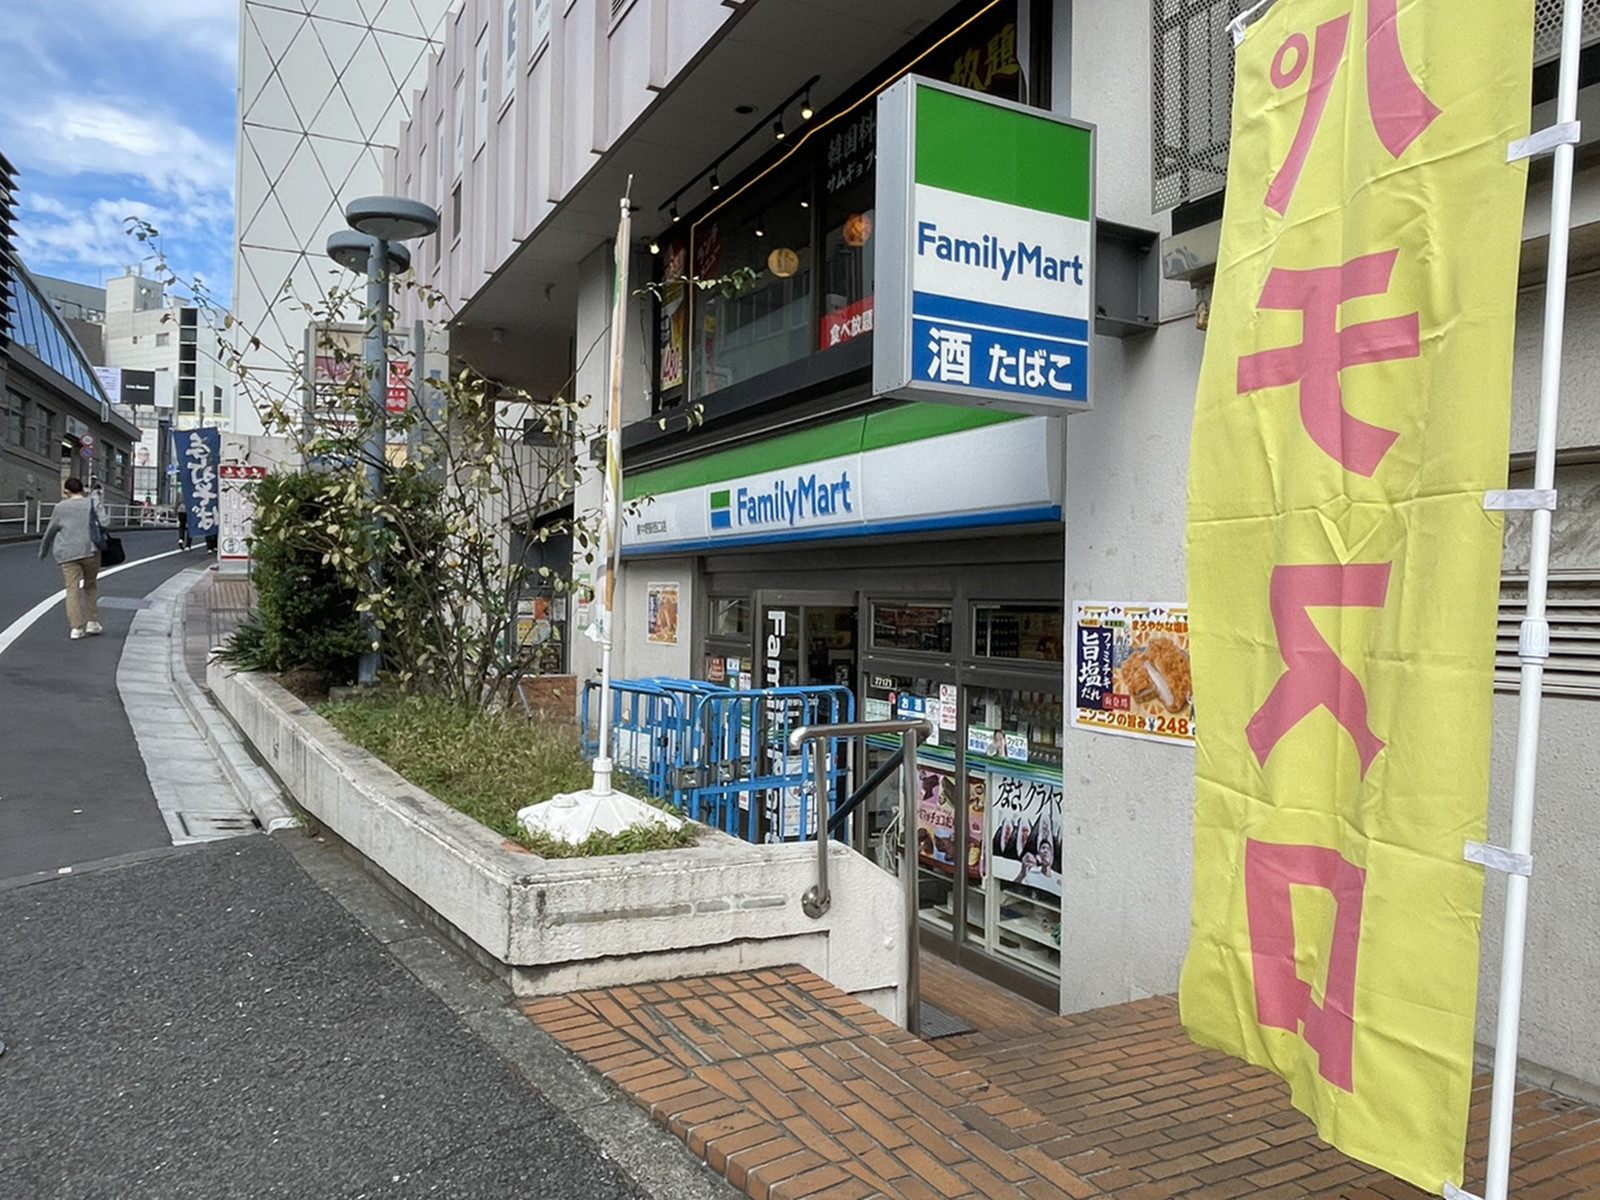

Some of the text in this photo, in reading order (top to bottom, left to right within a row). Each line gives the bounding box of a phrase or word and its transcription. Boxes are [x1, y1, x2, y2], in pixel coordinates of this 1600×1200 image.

[917, 221, 1083, 285] FamilyMart
[927, 327, 1072, 393] 酒 たばこ
[736, 470, 851, 526] FamilyMart
[1102, 632, 1112, 689] ファミチキ
